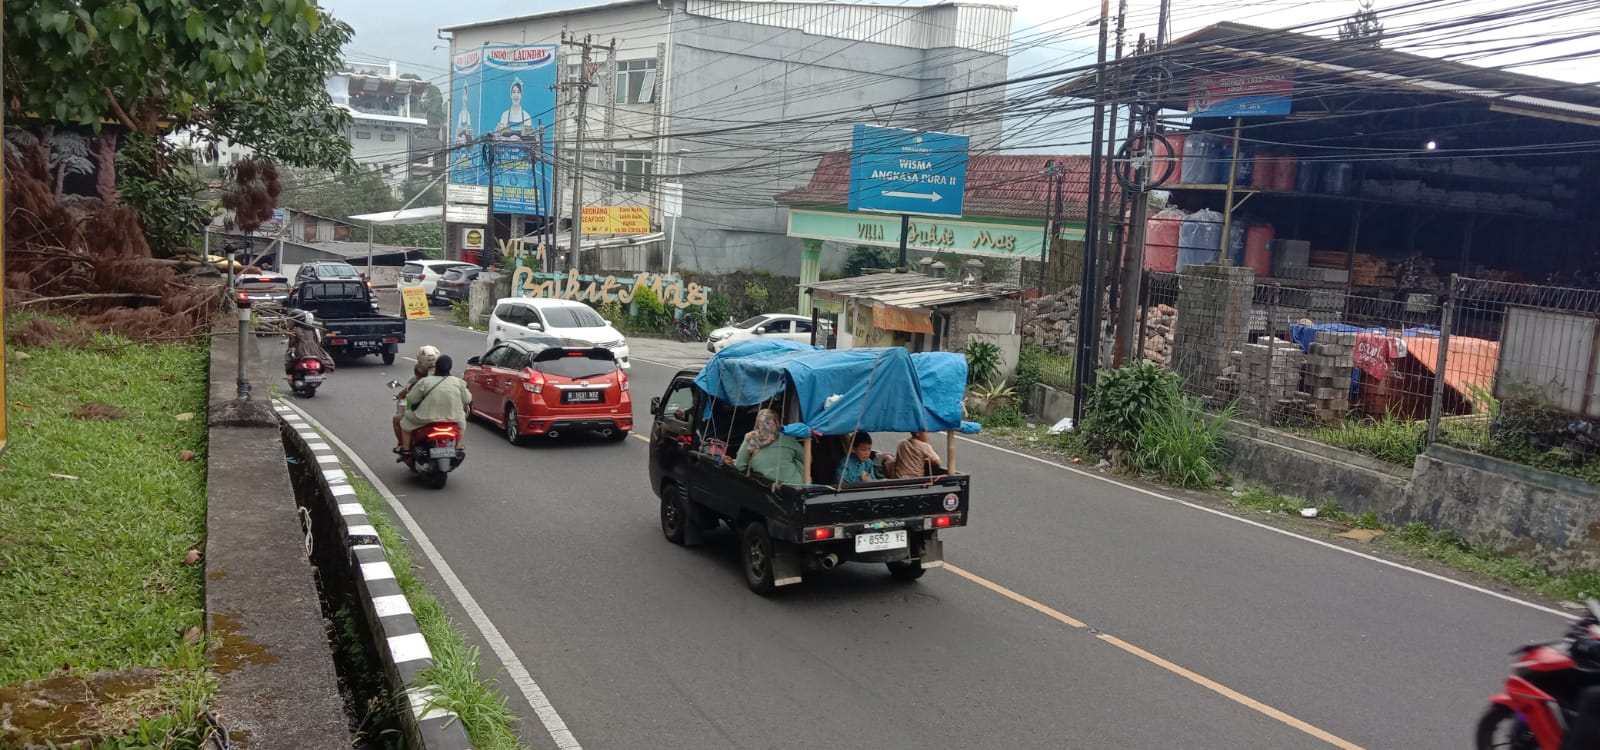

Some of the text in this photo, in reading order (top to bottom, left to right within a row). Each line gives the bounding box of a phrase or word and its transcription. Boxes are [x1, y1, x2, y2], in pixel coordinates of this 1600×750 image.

[491, 49, 546, 60] INDO LAUNDRY
[899, 159, 933, 170] WISMA
[871, 169, 956, 185] ANGKASA PURA II
[858, 222, 1016, 250] VILLA Bukit Mas
[512, 267, 708, 308] Bukit Mas
[858, 536, 862, 546] F
[895, 532, 905, 542] YE
